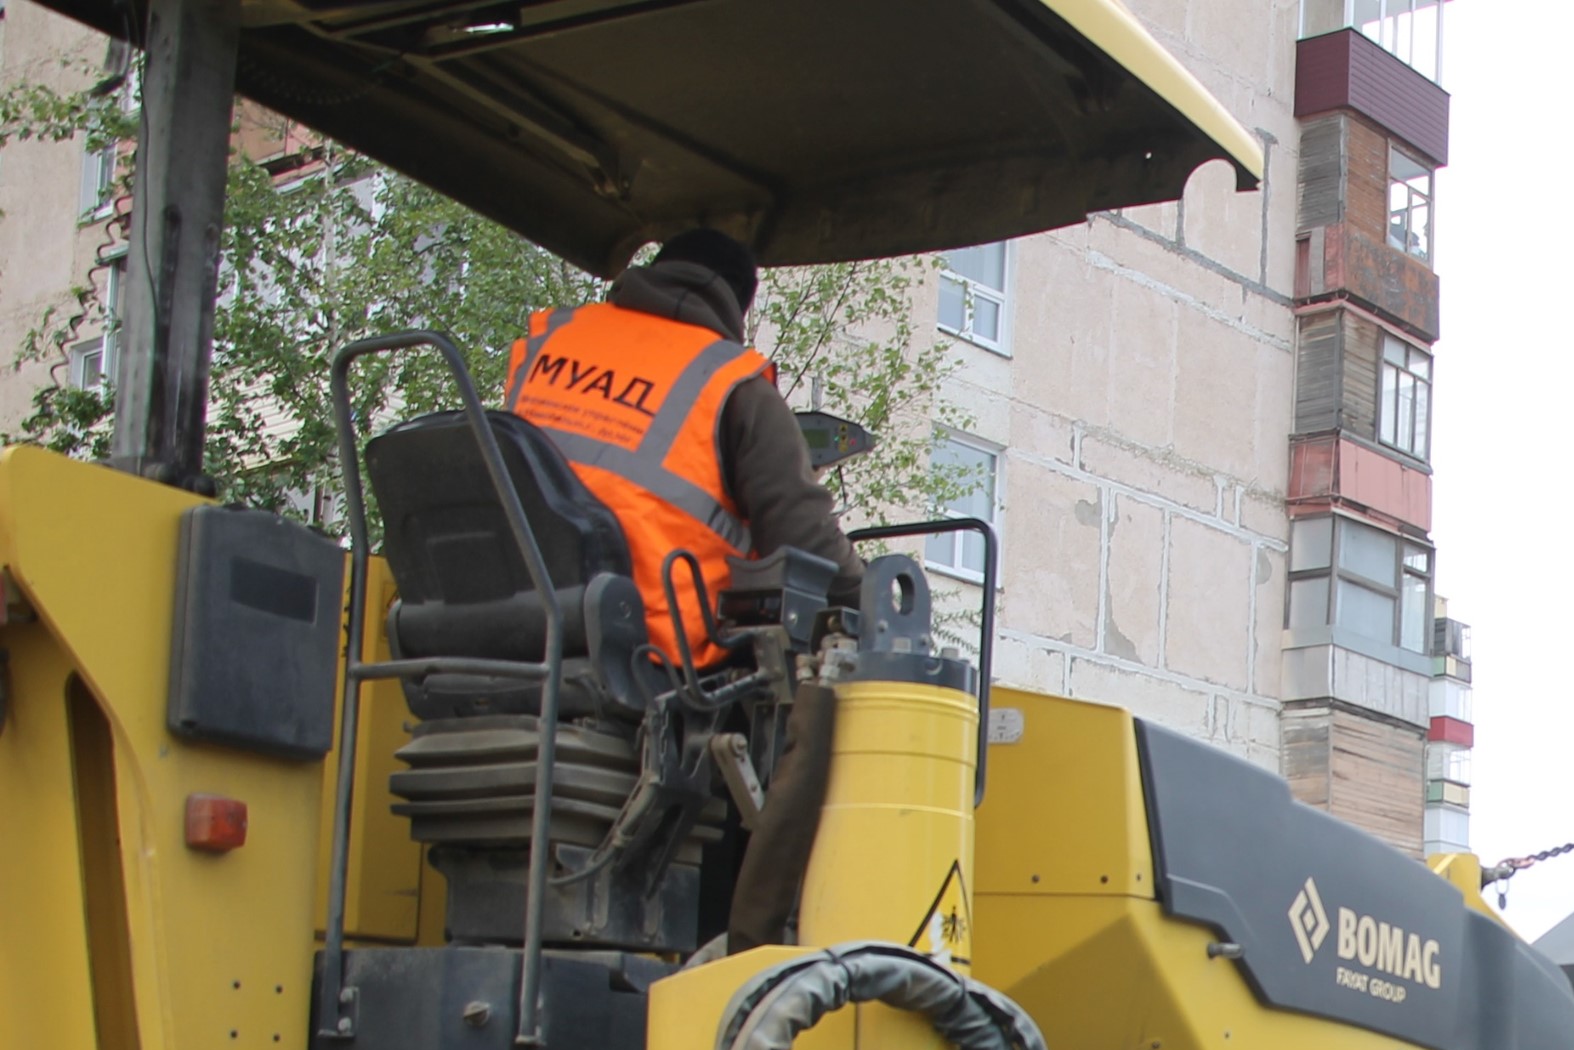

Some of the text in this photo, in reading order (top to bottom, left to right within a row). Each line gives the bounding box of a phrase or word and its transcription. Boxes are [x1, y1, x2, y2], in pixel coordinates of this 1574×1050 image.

[528, 353, 656, 417] МУАД
[1337, 906, 1441, 989] BOMAG
[1336, 966, 1406, 1003] FAYAT GROUP
